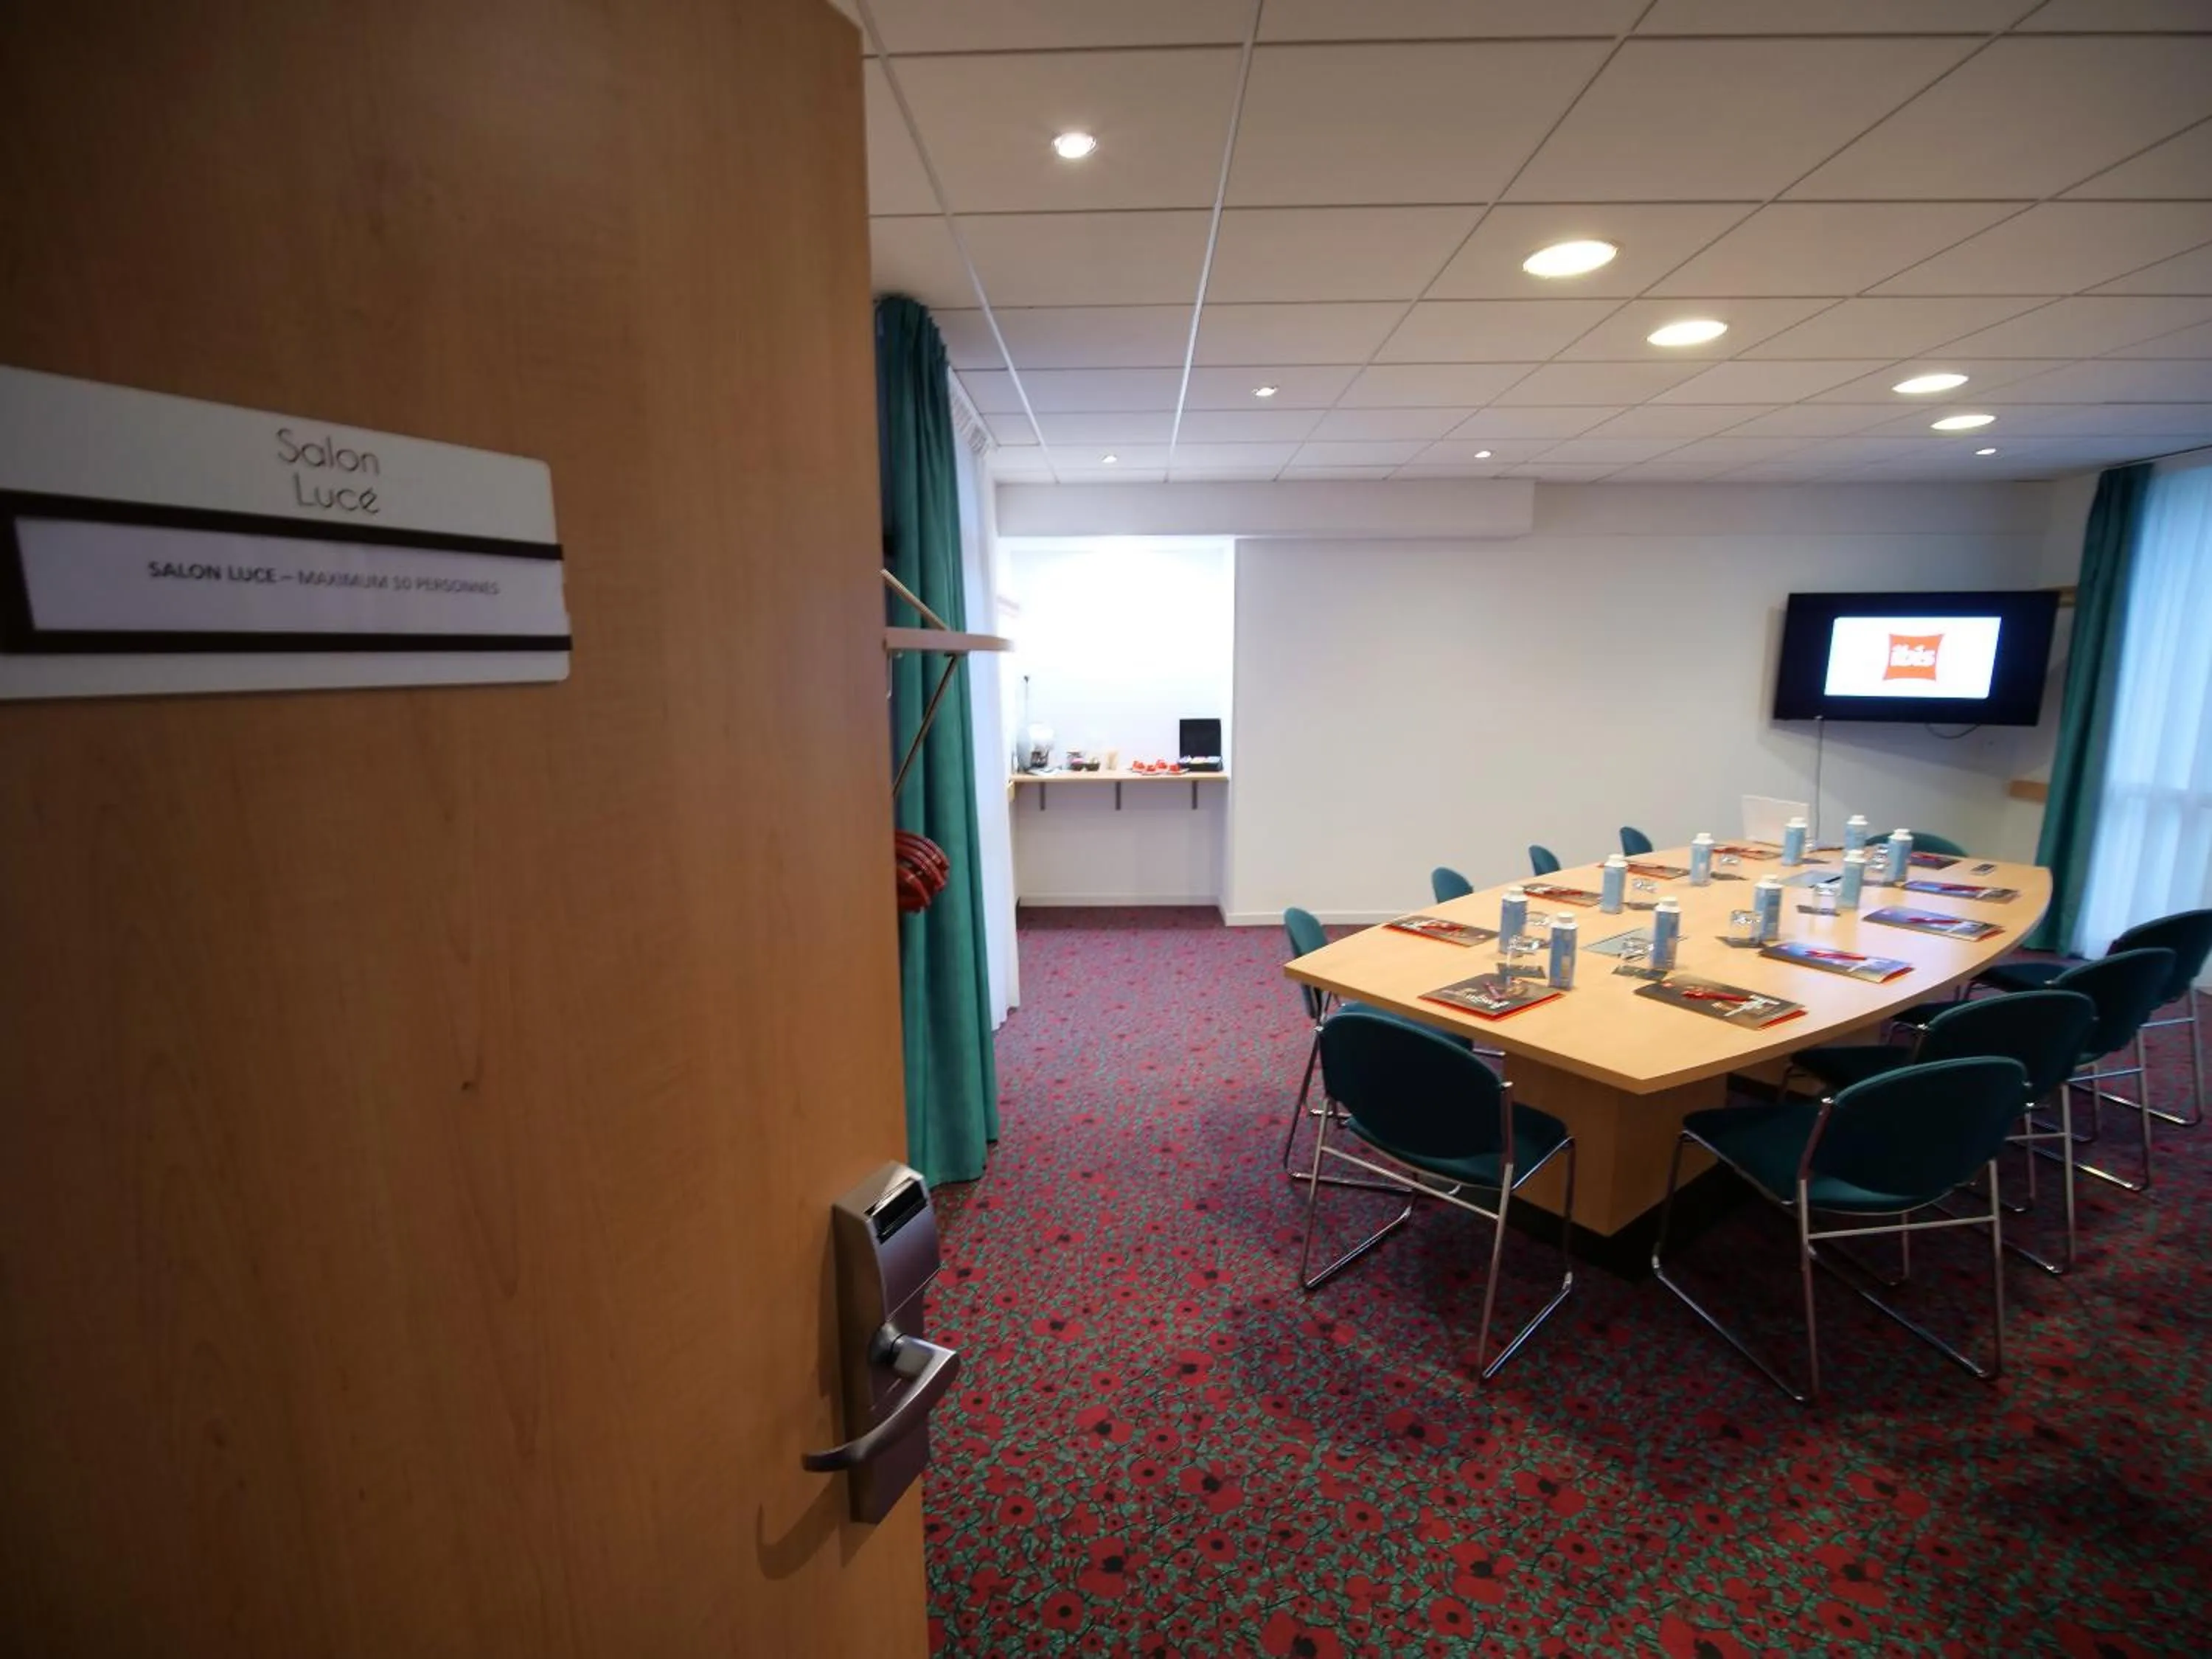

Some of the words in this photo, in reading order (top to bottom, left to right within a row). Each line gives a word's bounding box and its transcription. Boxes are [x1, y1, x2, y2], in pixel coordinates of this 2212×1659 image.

[276, 428, 380, 476] Salon
[147, 560, 220, 580] SALON
[227, 565, 276, 583] LUCE
[298, 569, 389, 588] MAXIMUM
[416, 576, 500, 595] PERSONNES
